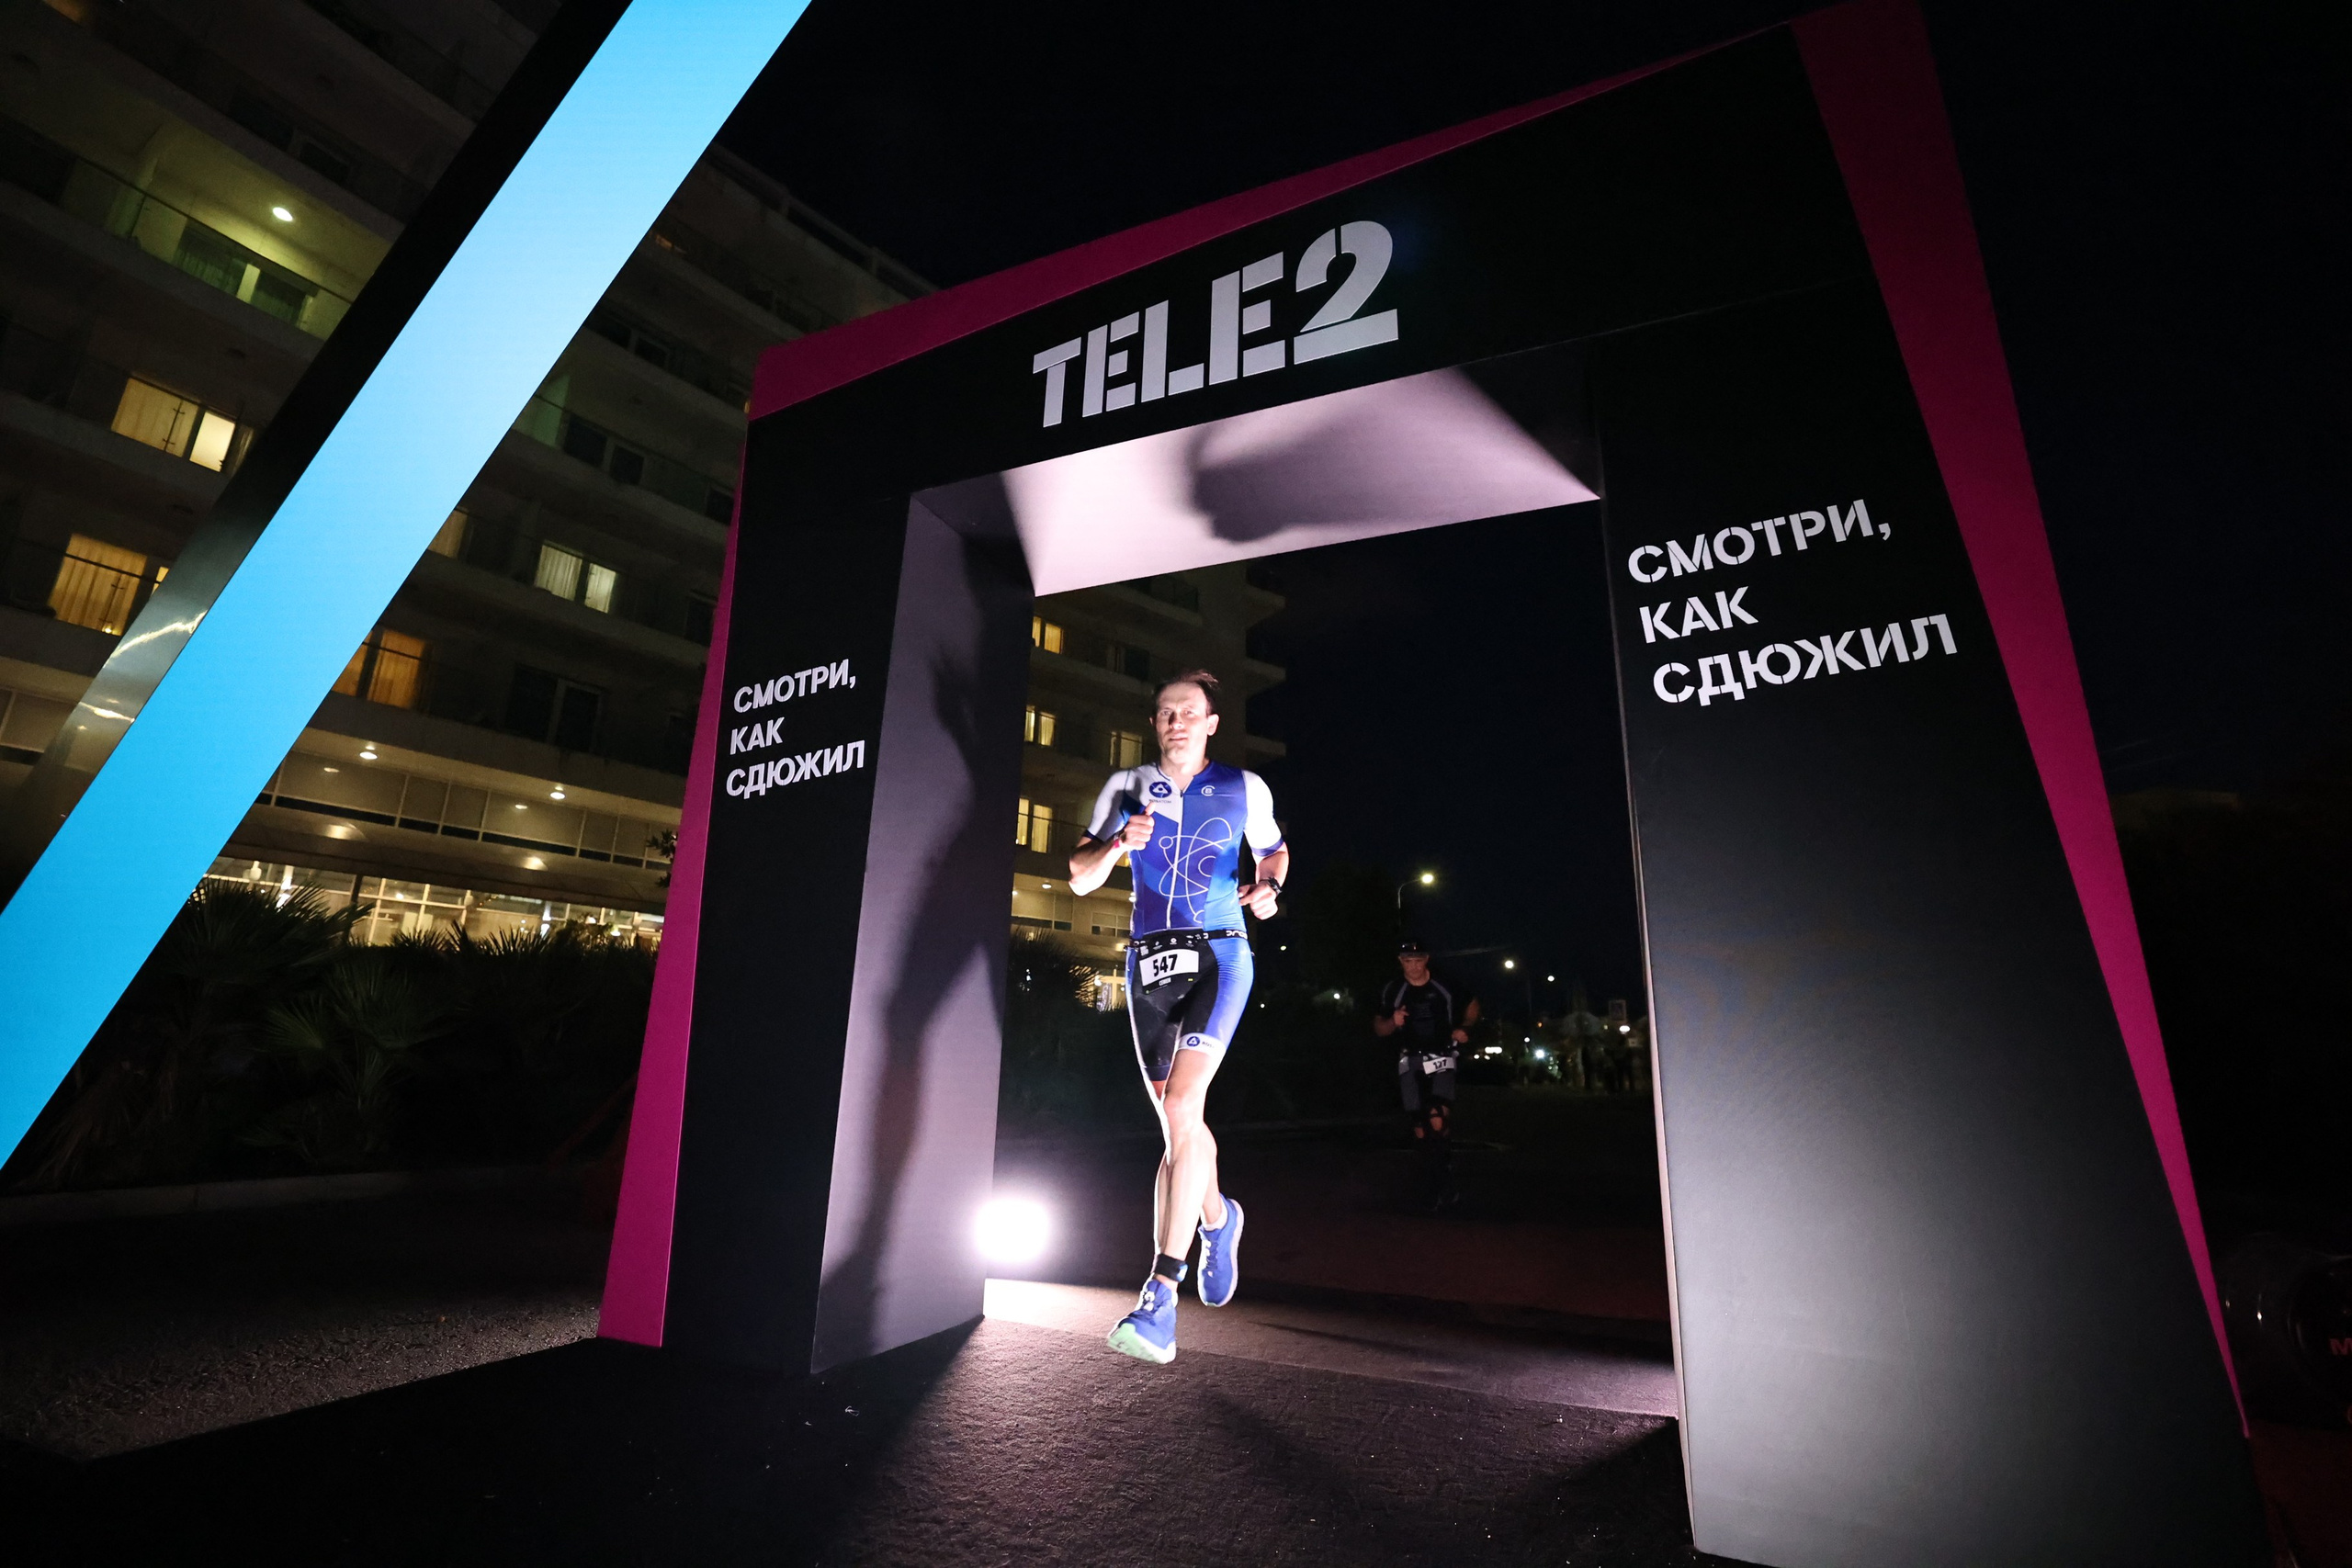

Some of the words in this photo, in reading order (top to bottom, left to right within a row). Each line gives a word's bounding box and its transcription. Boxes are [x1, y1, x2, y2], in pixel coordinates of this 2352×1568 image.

[1033, 220, 1399, 428] TELE2
[1628, 499, 1892, 583] СМОТРИ,
[1639, 585, 1758, 644] КАК
[733, 659, 856, 714] СМОТРИ,
[1653, 614, 1958, 707] СДЮЖИЛ
[729, 716, 785, 755] КАК
[726, 739, 865, 800] СДЮЖИЛ
[1152, 953, 1178, 977] 547
